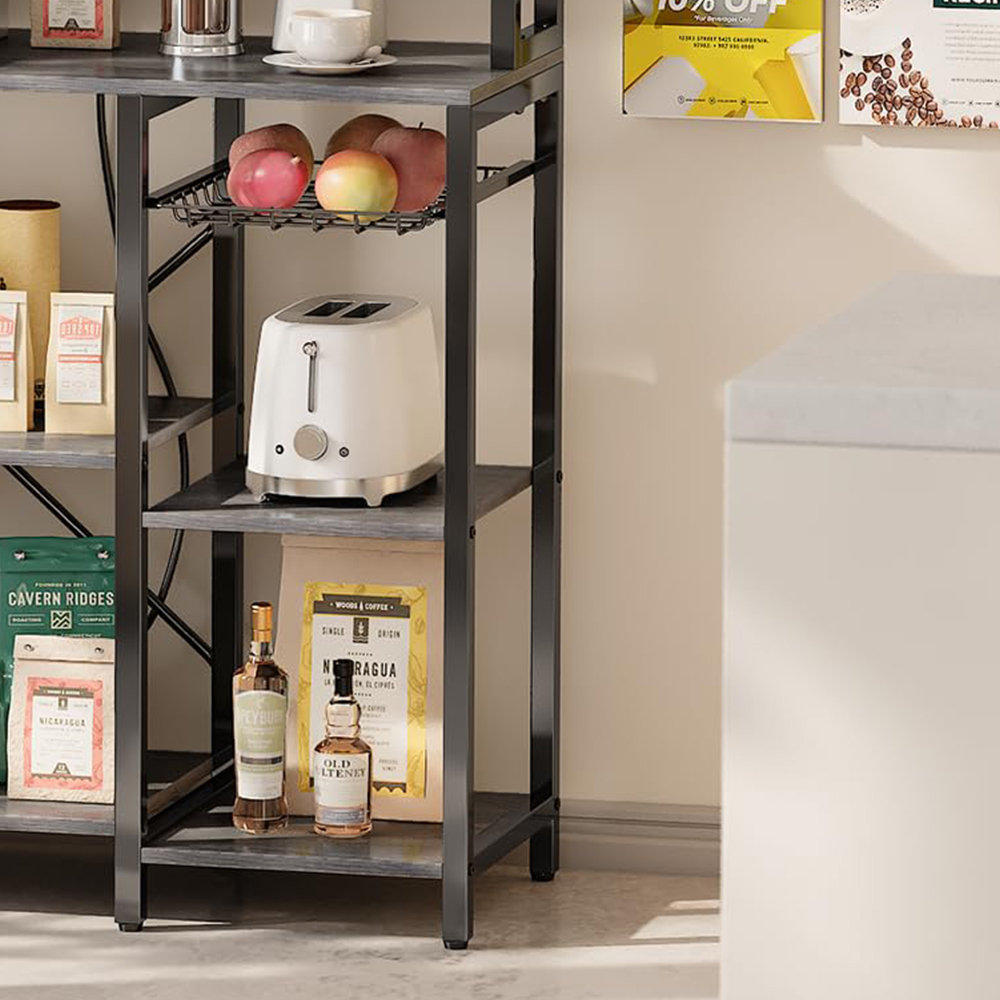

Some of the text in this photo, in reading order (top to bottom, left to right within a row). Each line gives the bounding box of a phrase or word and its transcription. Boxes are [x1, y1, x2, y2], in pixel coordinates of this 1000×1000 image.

[8, 591, 115, 606] CAVERN RIDGES
[364, 603, 389, 611] COFFEE
[322, 626, 401, 638] SINGLE ORIGIN
[323, 660, 397, 678] NRAGUA
[323, 759, 351, 769] OLD
[320, 767, 366, 778] LTENEY
